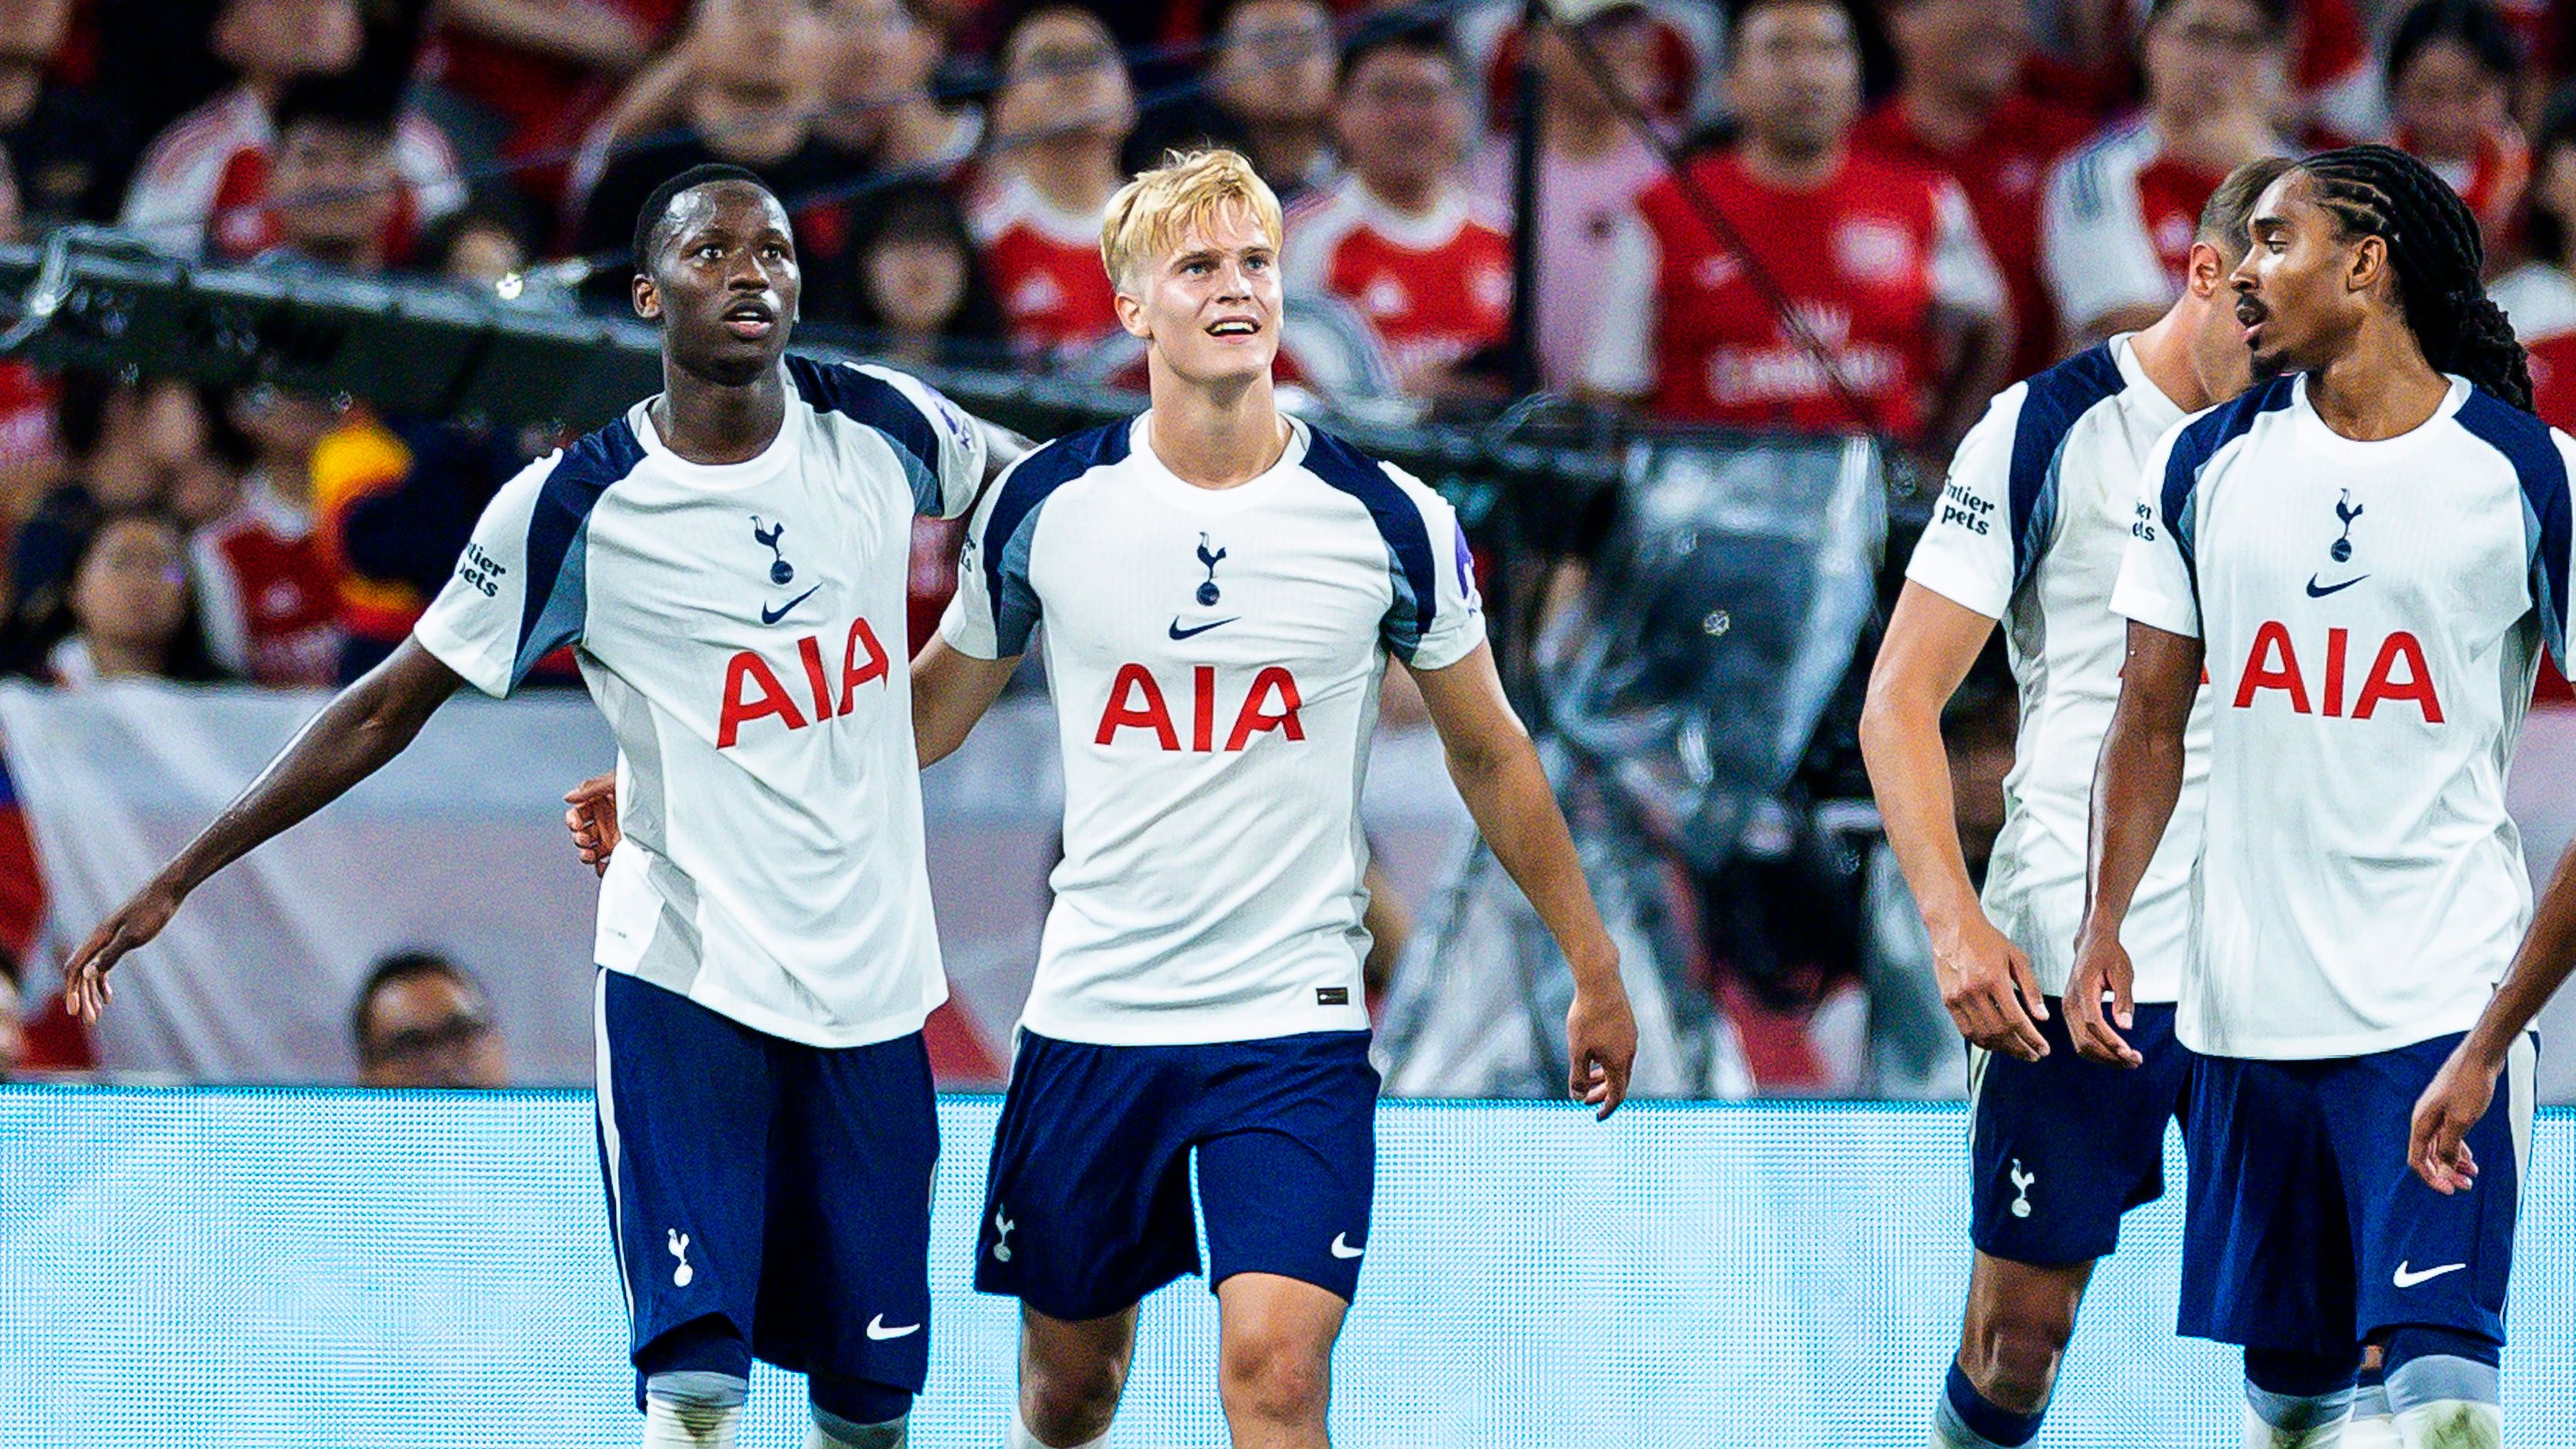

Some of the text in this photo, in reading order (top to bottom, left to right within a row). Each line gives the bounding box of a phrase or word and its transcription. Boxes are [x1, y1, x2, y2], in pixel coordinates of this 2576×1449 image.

[1946, 475, 1994, 515] ntier
[467, 542, 506, 578] tier
[716, 616, 889, 750] AIA
[1094, 662, 1306, 752] AIA
[2233, 620, 2445, 723] AIA
